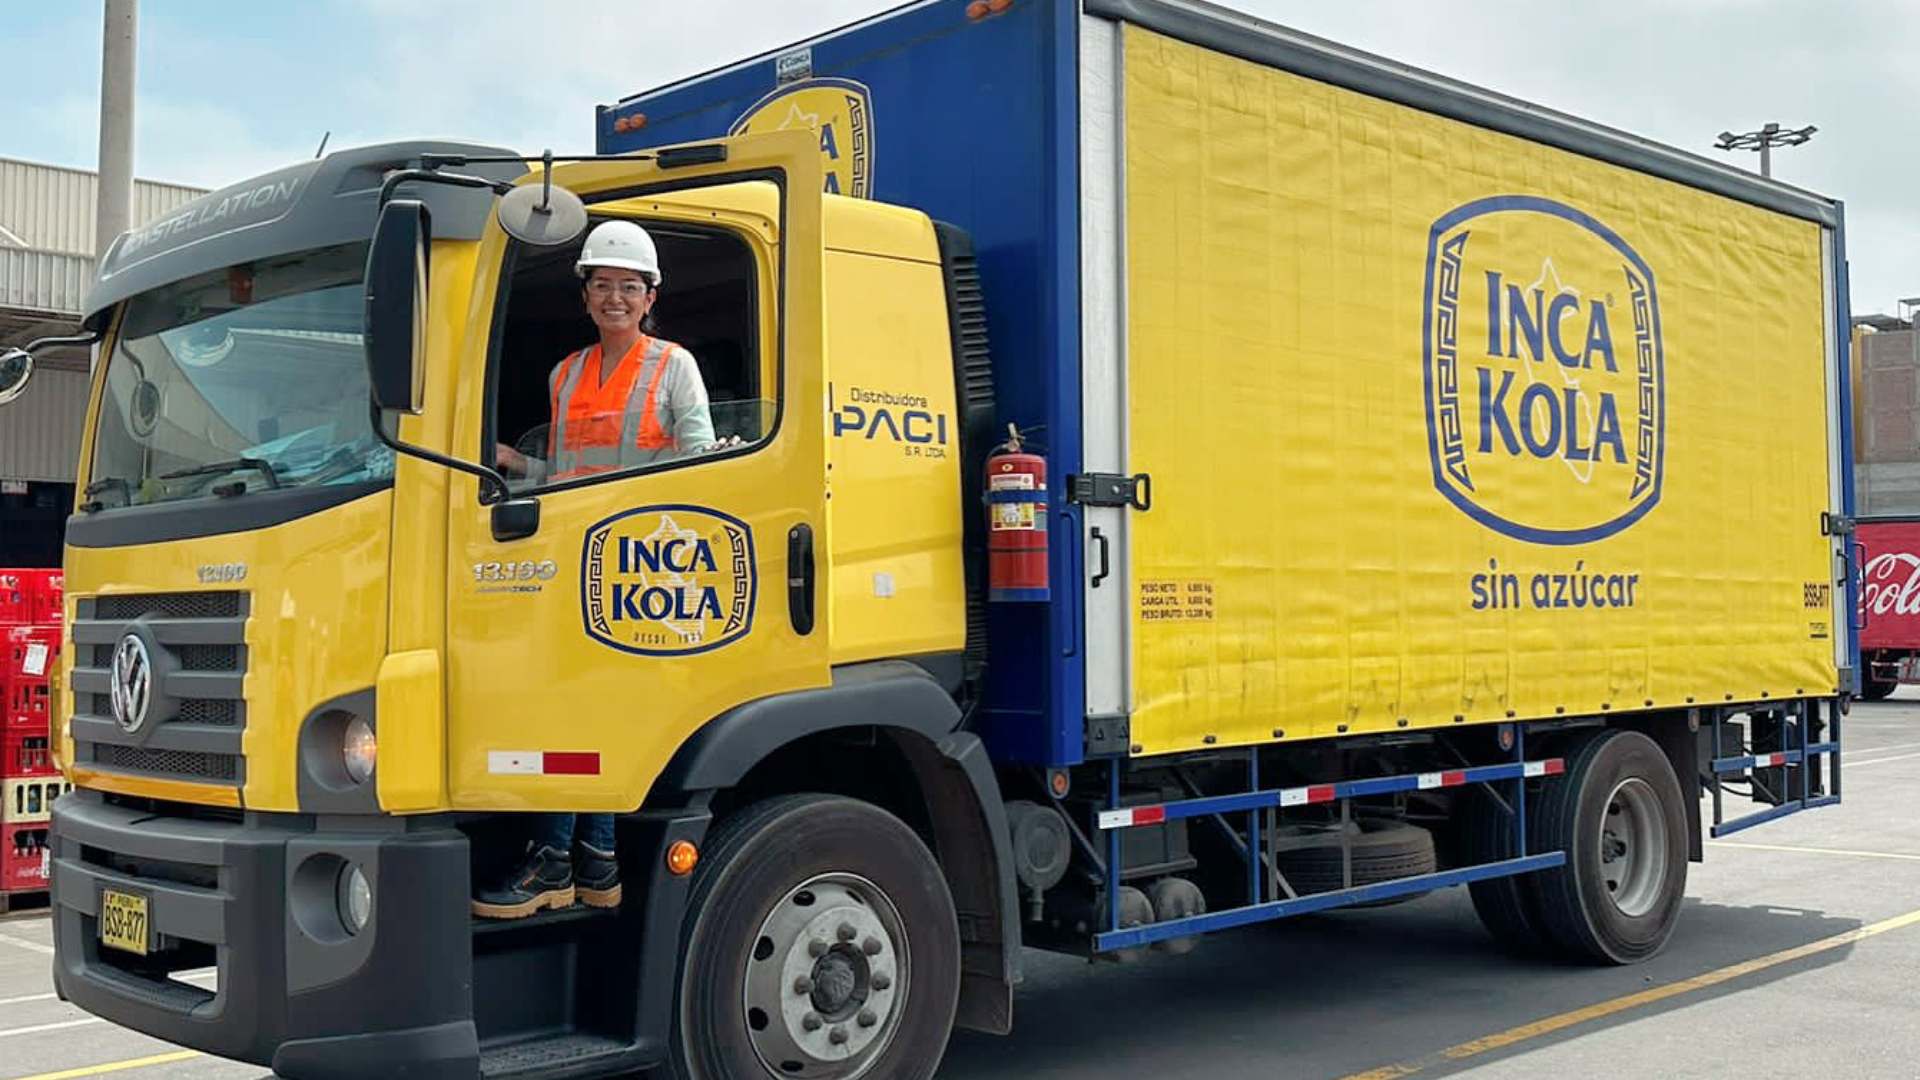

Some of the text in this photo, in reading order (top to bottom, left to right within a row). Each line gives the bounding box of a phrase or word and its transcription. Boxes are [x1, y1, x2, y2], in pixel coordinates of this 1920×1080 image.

[1485, 270, 1619, 373] INCA
[851, 387, 927, 407] Distribuidora
[1476, 366, 1628, 465] KOLA
[833, 405, 946, 445] PACI
[618, 536, 718, 573] INCA
[612, 583, 724, 621] KOLA
[1141, 596, 1163, 606] CARGA
[1471, 558, 1639, 609] sin azúcar
[1141, 609, 1158, 619] PESO
[105, 905, 144, 945] BSB-877
